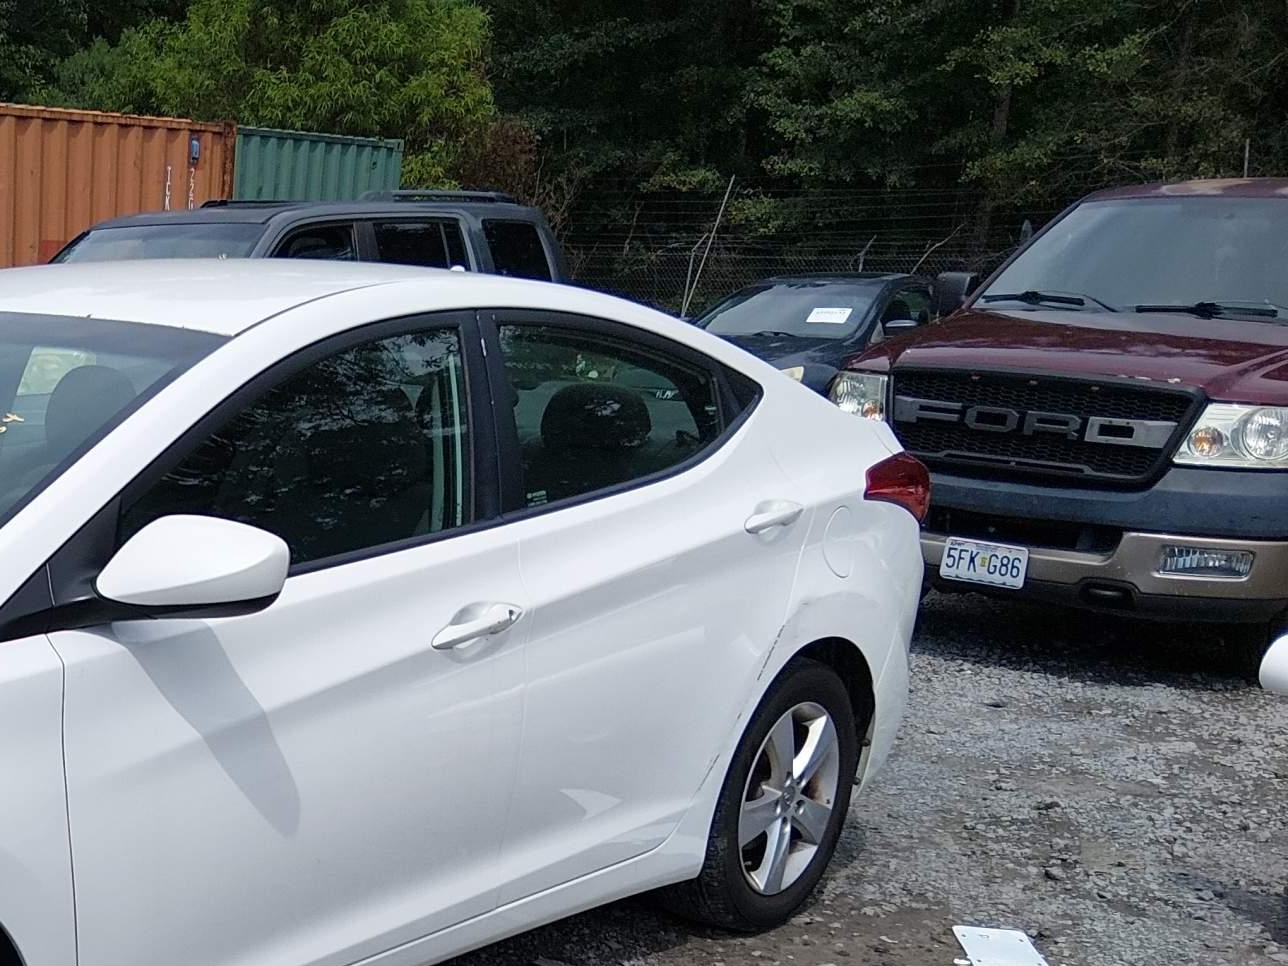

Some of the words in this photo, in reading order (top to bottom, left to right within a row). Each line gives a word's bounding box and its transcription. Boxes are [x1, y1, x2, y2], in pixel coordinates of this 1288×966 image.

[895, 396, 1178, 448] FORD
[946, 547, 980, 573] 5FK
[987, 554, 1022, 579] G86
